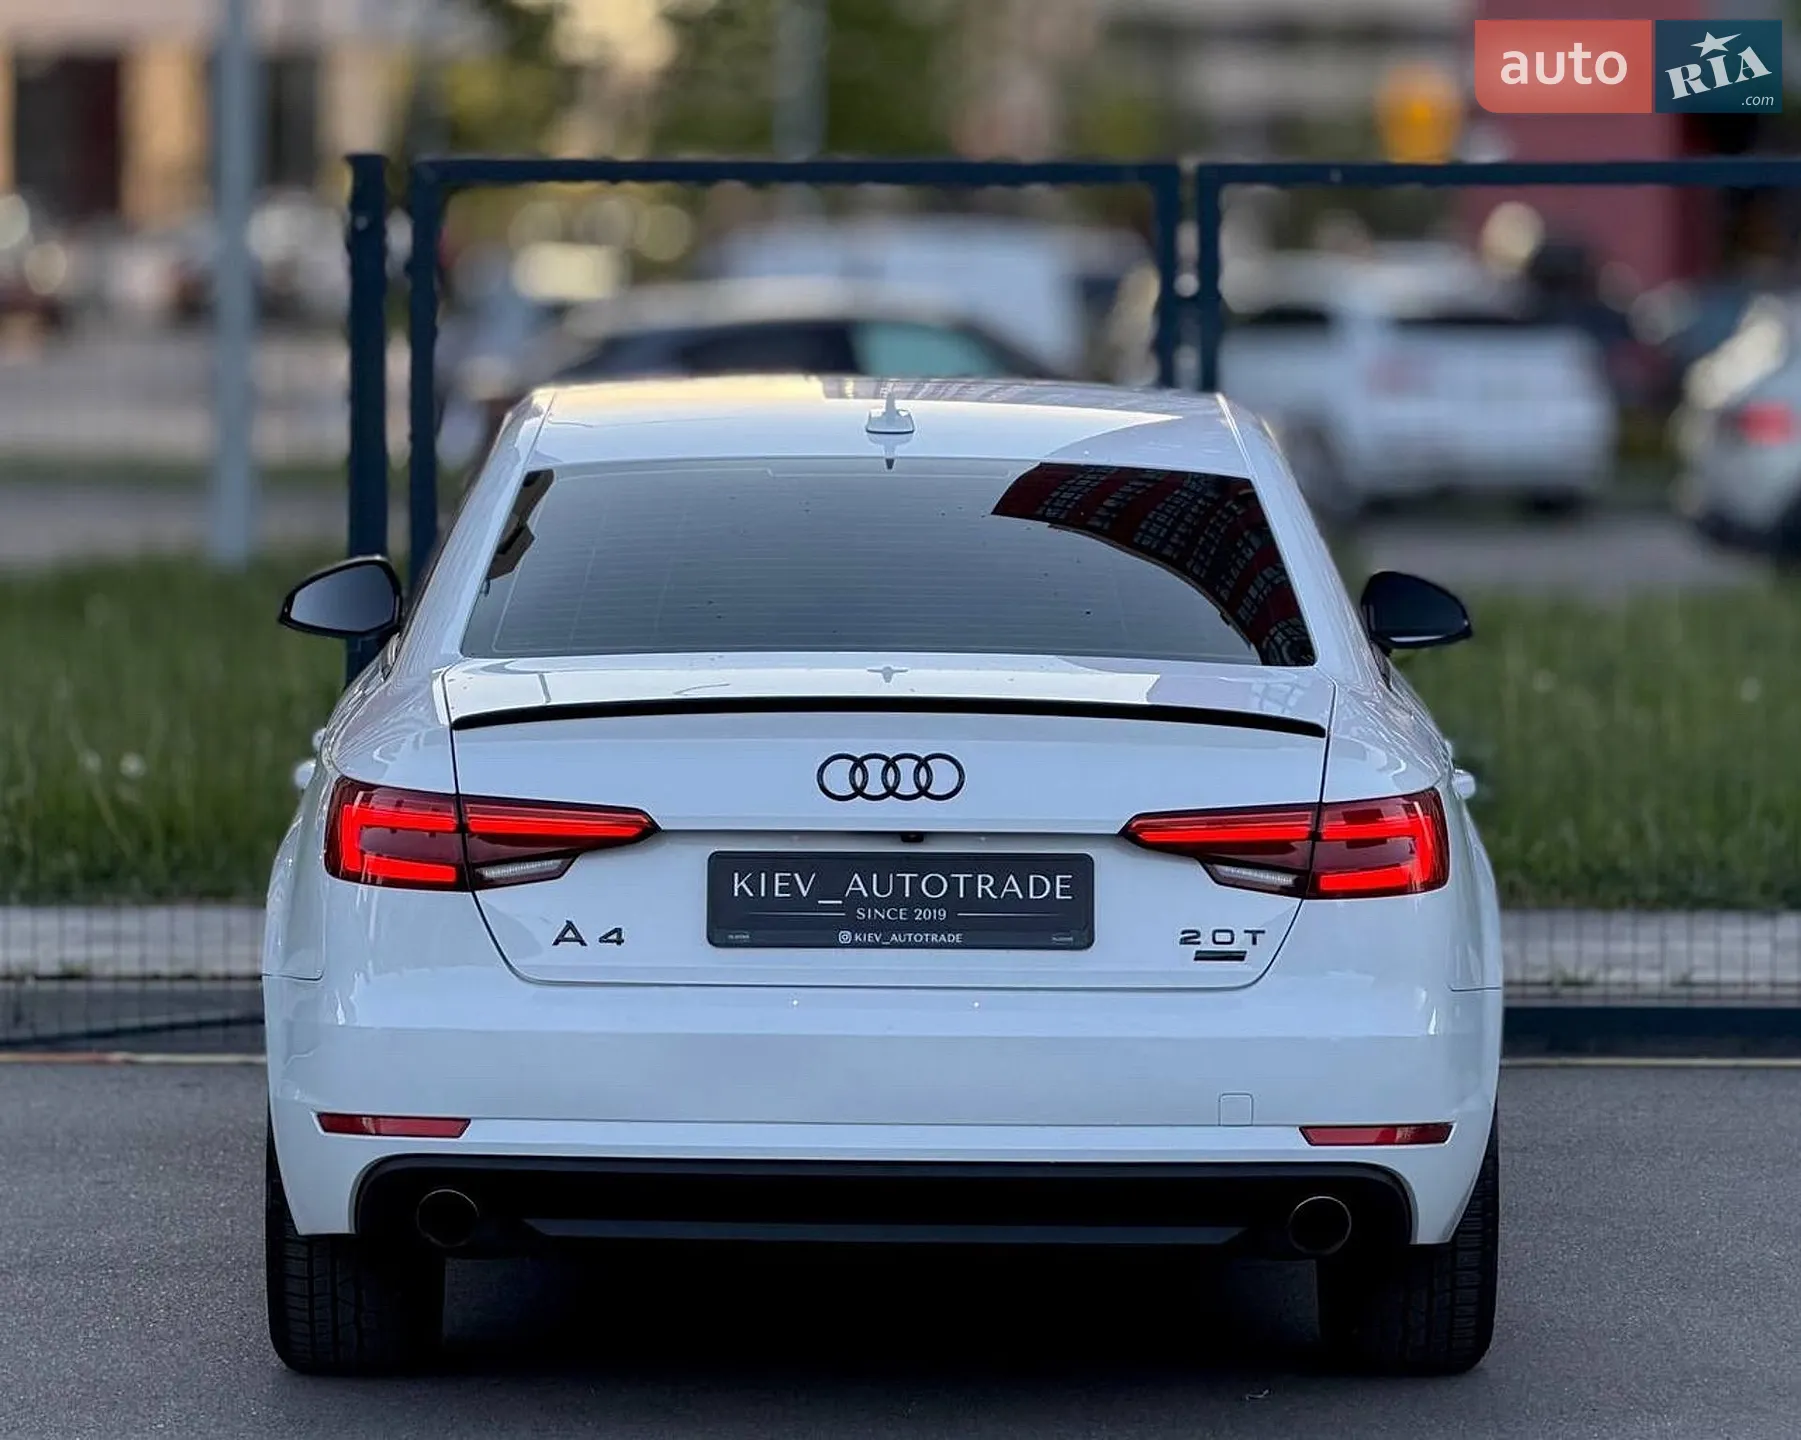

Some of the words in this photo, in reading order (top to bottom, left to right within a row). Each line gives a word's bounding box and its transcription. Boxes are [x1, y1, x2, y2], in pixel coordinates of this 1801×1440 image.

[732, 871, 1074, 904] KIEV_AUTOTRADE
[856, 907, 909, 921] SINCE
[914, 907, 948, 921] 2019
[855, 932, 964, 945] KIEV_AUTOTRADE
